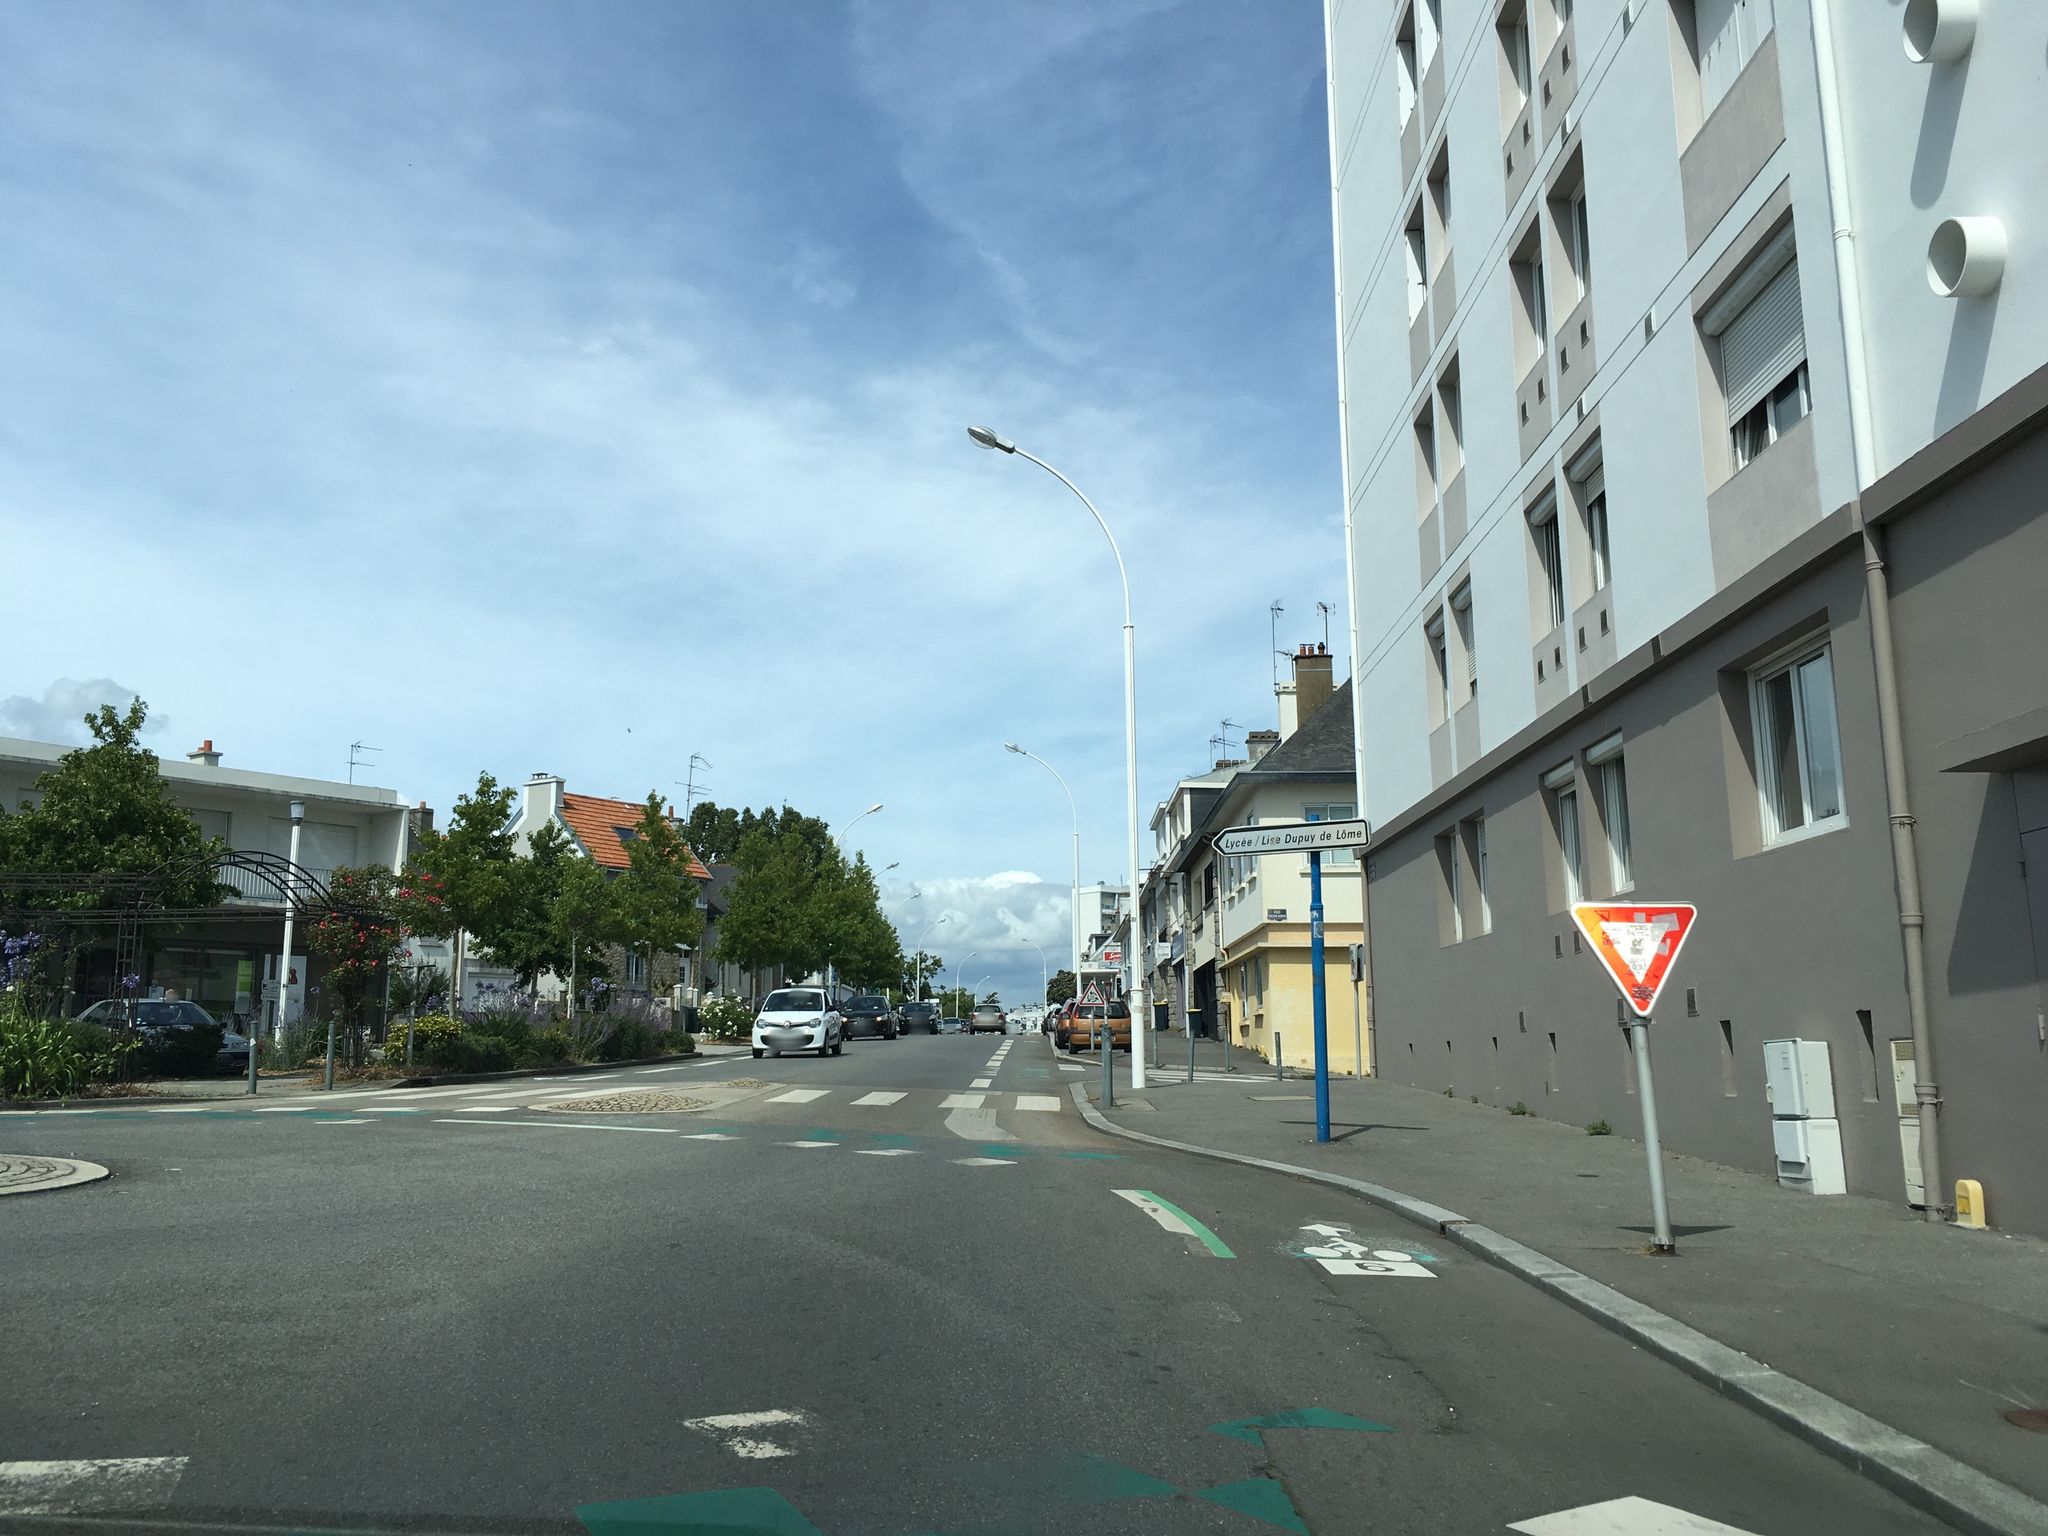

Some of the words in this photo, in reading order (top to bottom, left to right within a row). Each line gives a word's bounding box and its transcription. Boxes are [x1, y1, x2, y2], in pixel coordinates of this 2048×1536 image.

[1225, 838, 1252, 850] Lycée
[1285, 833, 1315, 845] Dupuy
[1320, 831, 1332, 841] de
[1336, 829, 1362, 840] Lôme
